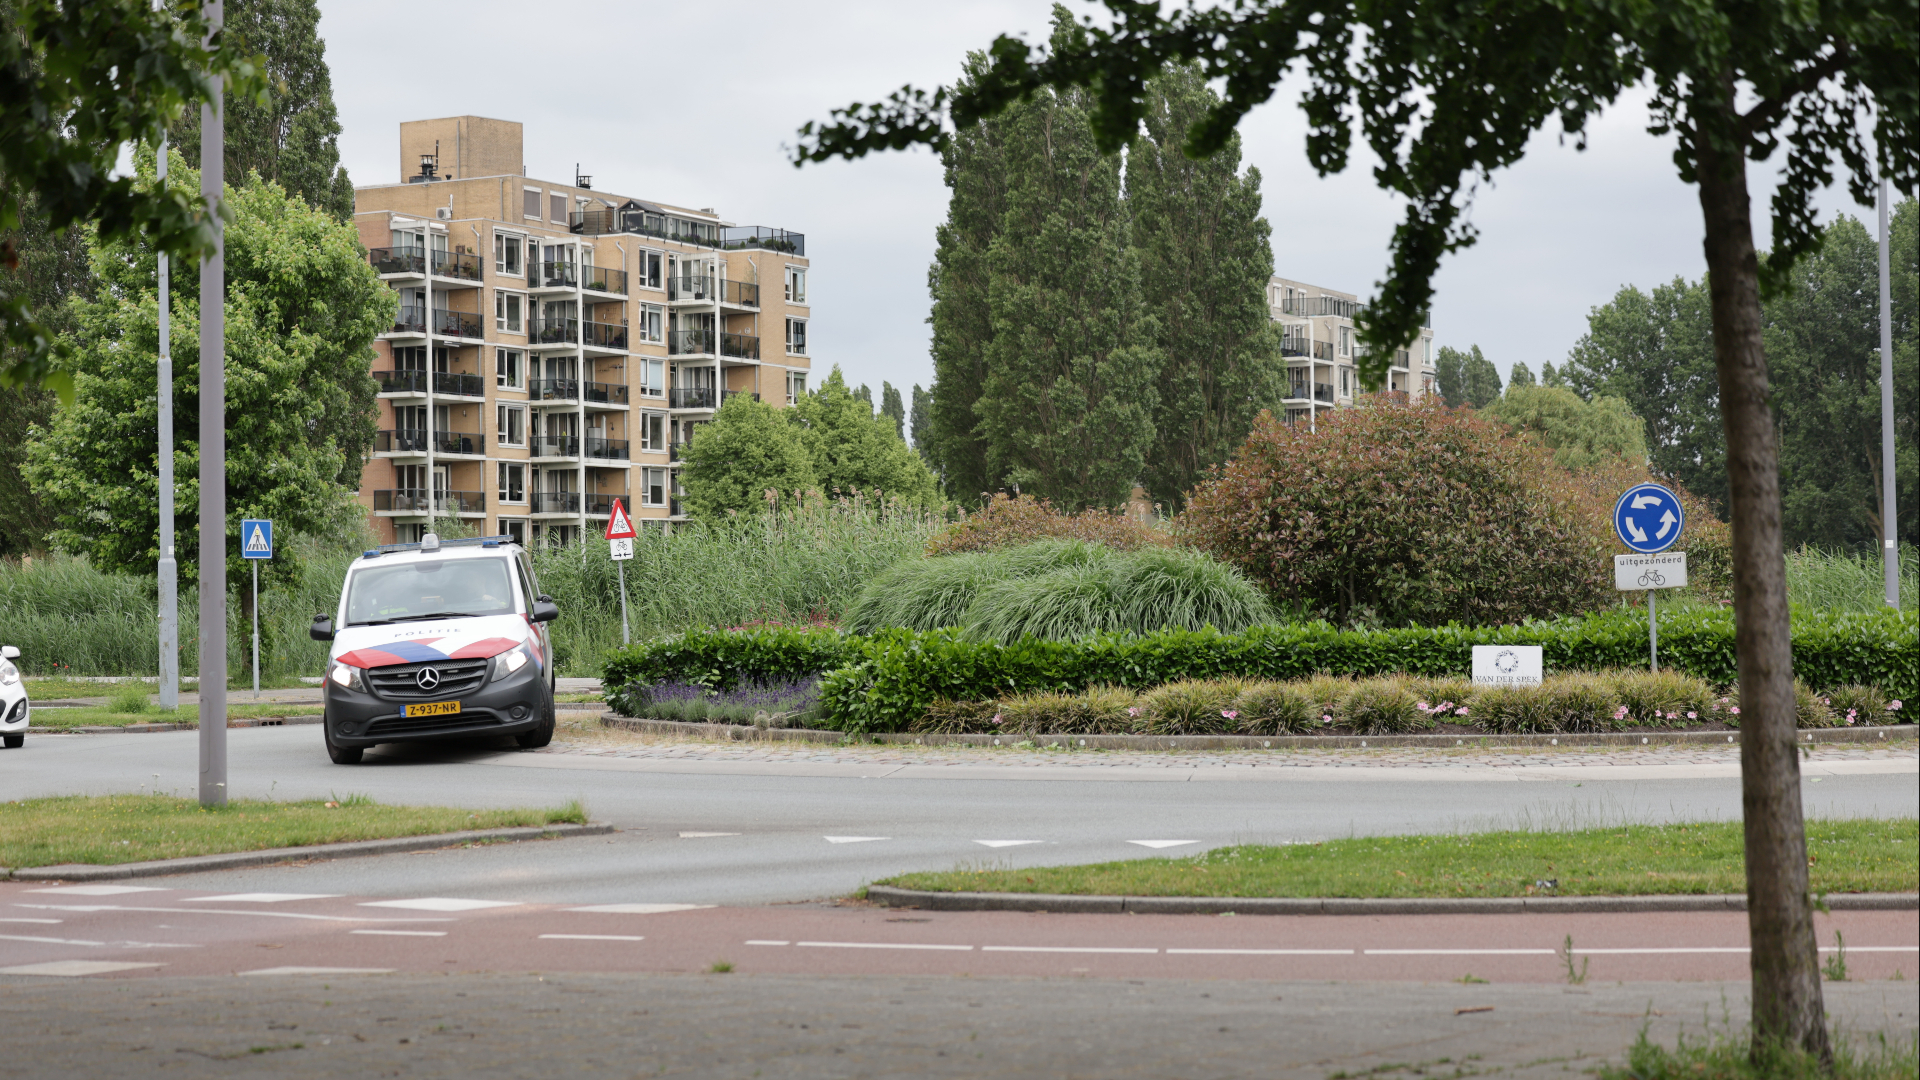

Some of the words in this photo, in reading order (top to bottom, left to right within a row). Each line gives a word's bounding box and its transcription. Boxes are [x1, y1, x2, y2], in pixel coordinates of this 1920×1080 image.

[1619, 556, 1682, 567] uitgezonderd
[394, 628, 461, 638] POLITIE
[1475, 675, 1494, 683] VAN
[1496, 675, 1514, 683] DER
[1516, 675, 1538, 683] SPEK
[409, 702, 457, 716] Z-937-NR
